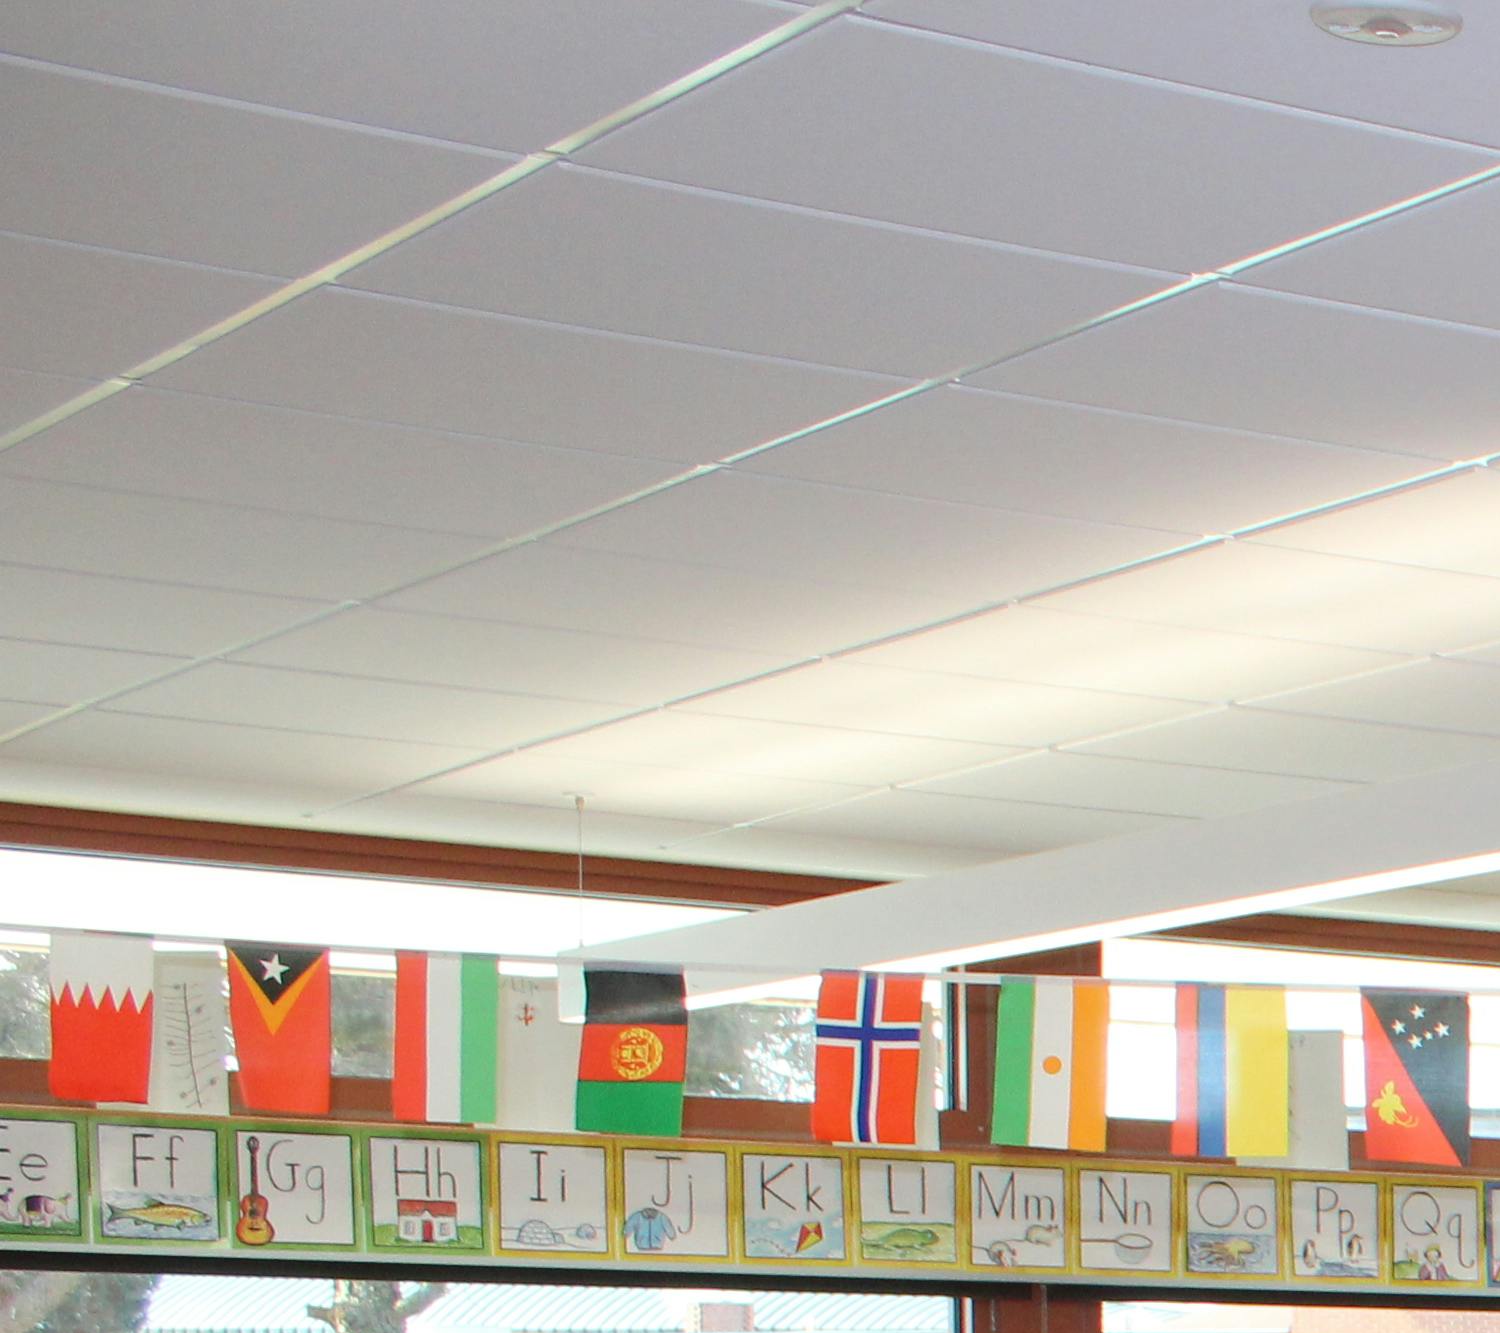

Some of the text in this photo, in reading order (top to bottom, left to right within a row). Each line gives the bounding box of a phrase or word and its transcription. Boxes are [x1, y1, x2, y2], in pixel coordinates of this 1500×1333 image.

[131, 1133, 185, 1188] Ff
[266, 1139, 325, 1225] Gg
[393, 1145, 456, 1198] Hh
[529, 1150, 567, 1202] Ii
[651, 1155, 695, 1235] Jj
[760, 1161, 824, 1212] Kk
[887, 1164, 926, 1215] Ll
[977, 1170, 1055, 1221] Mm
[1098, 1177, 1152, 1226] Nn
[1196, 1181, 1268, 1230] Oo
[1315, 1186, 1355, 1258] Pp
[1401, 1191, 1475, 1269] Qq
